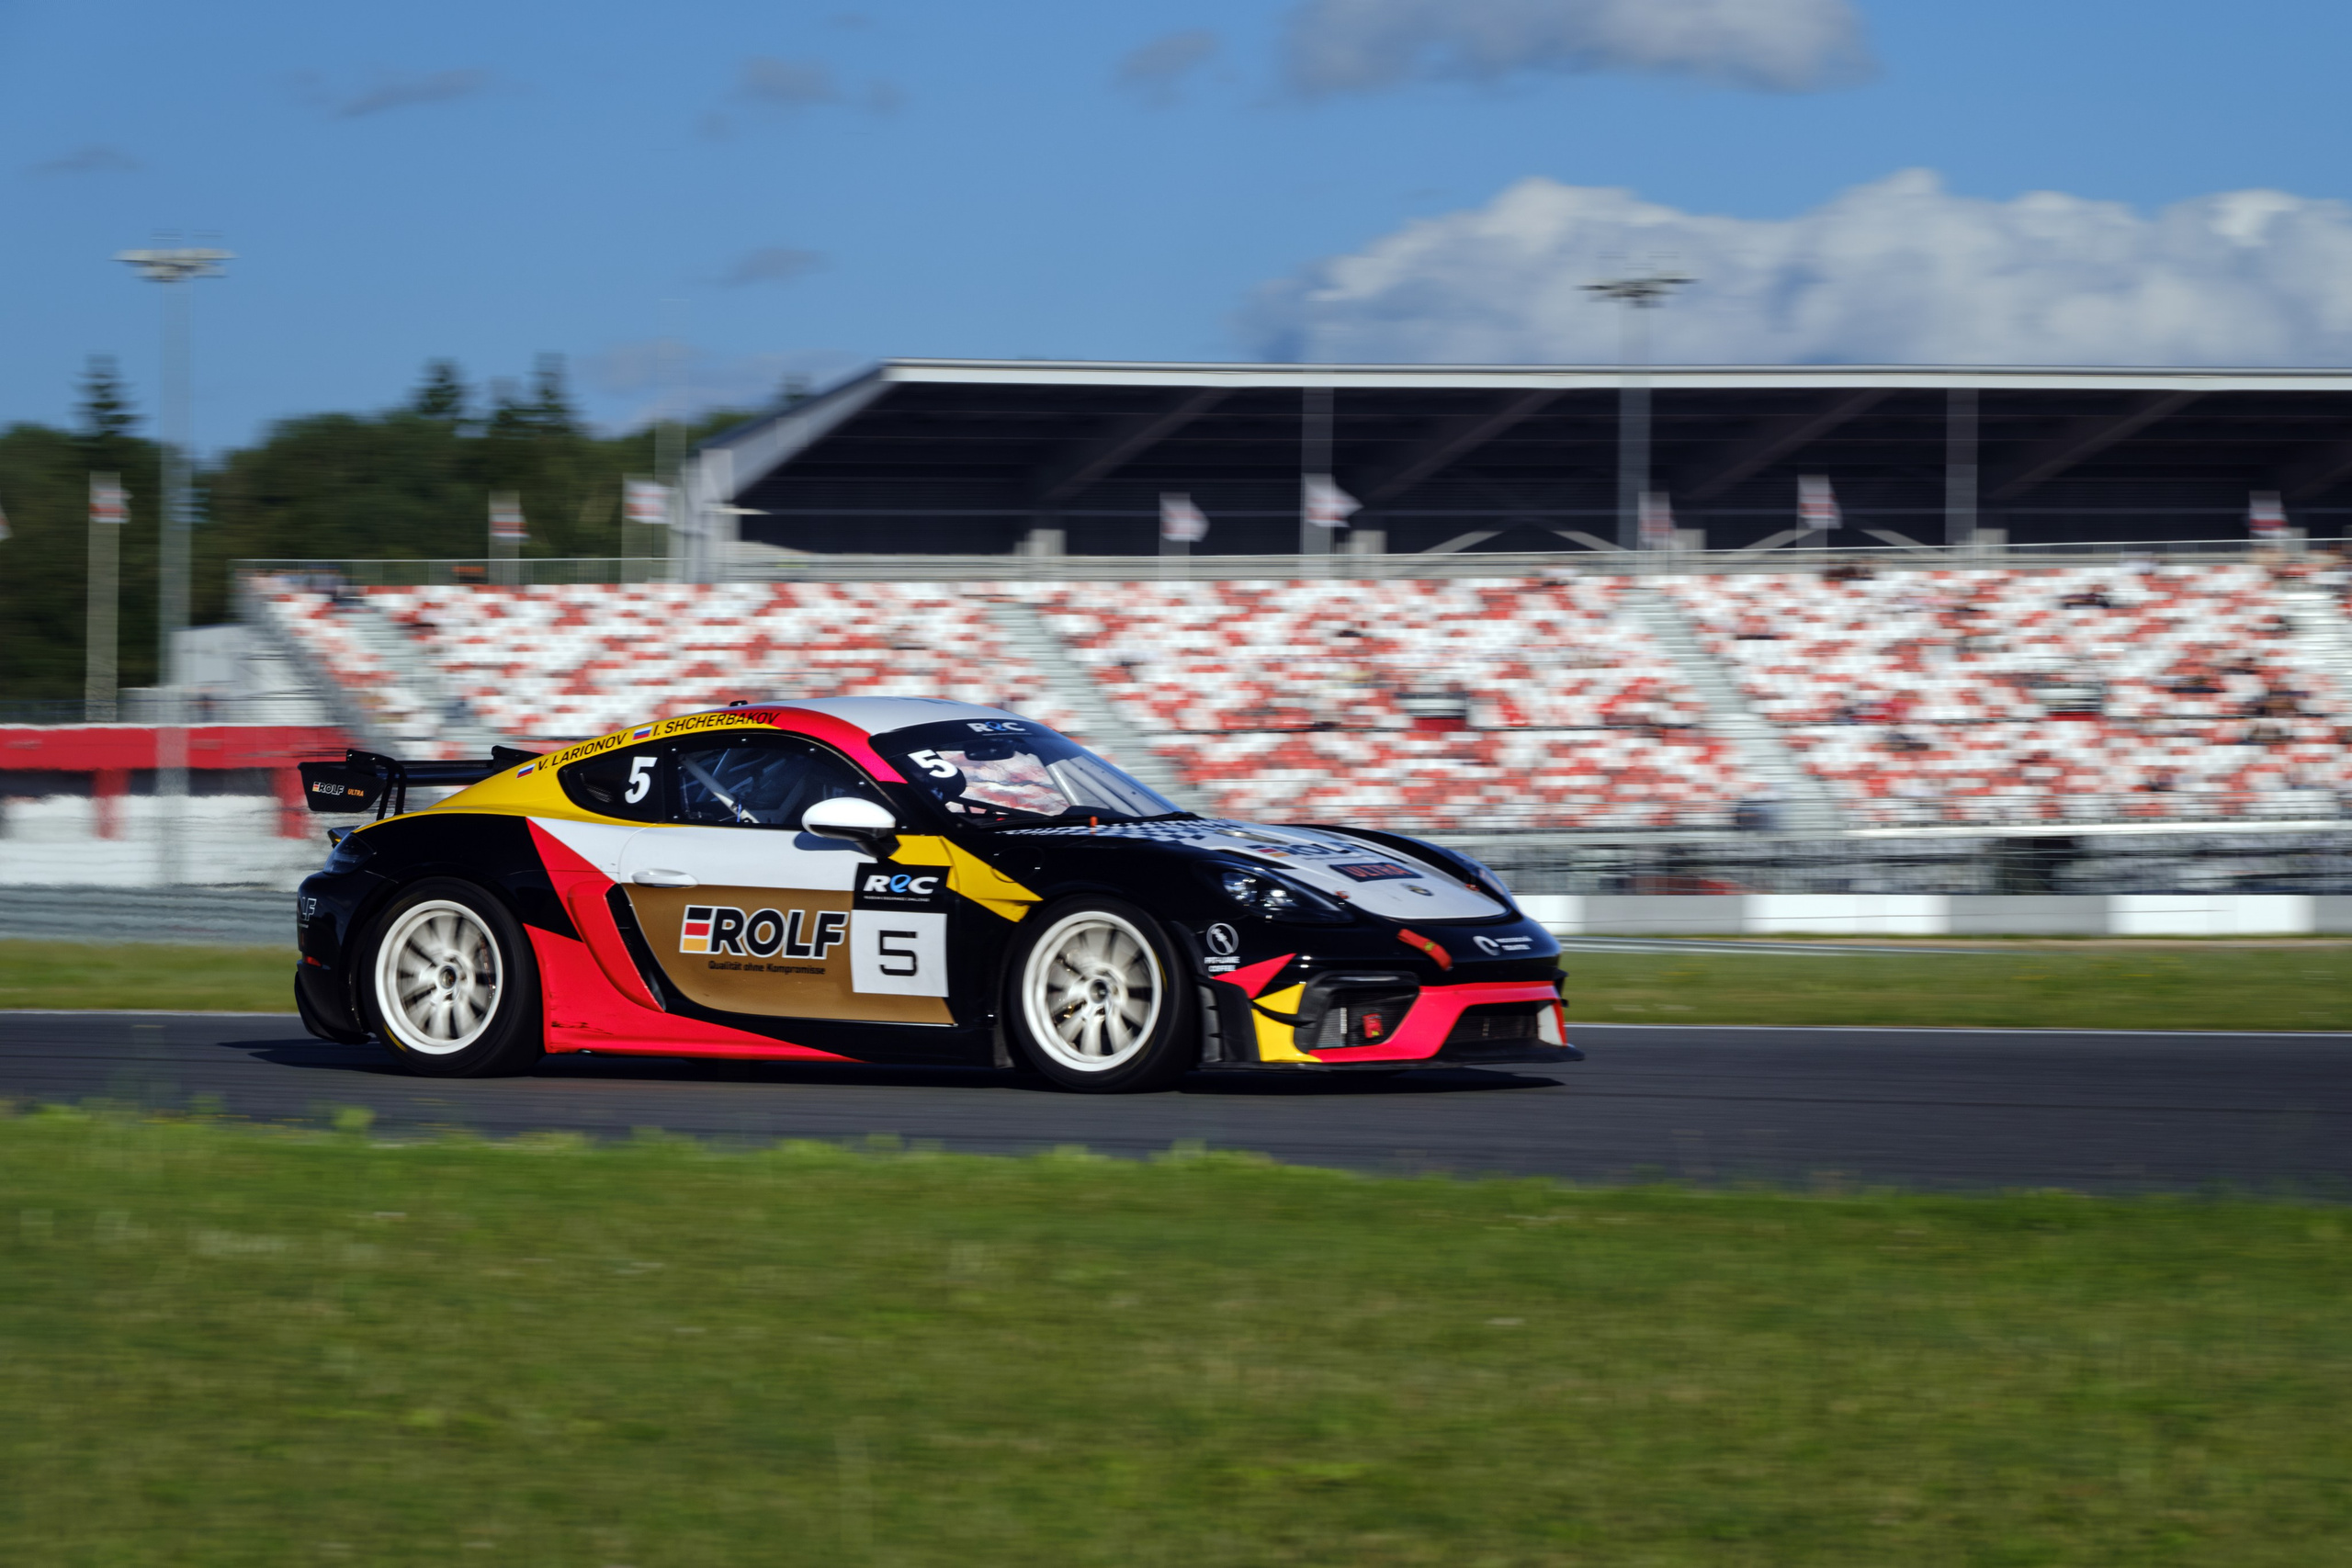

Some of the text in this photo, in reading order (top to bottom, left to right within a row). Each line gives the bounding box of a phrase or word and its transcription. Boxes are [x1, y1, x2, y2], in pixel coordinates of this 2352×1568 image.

[652, 712, 780, 737] I. SHCHERBAKOV
[537, 732, 628, 771] V. LARIONOV
[907, 750, 958, 778] 5
[319, 783, 364, 797] ROLF ULTRA
[625, 756, 658, 804] 5
[709, 907, 850, 960] ROLF
[743, 962, 764, 972] ohne
[766, 963, 825, 976] Kompromisse
[877, 930, 919, 976] 5
